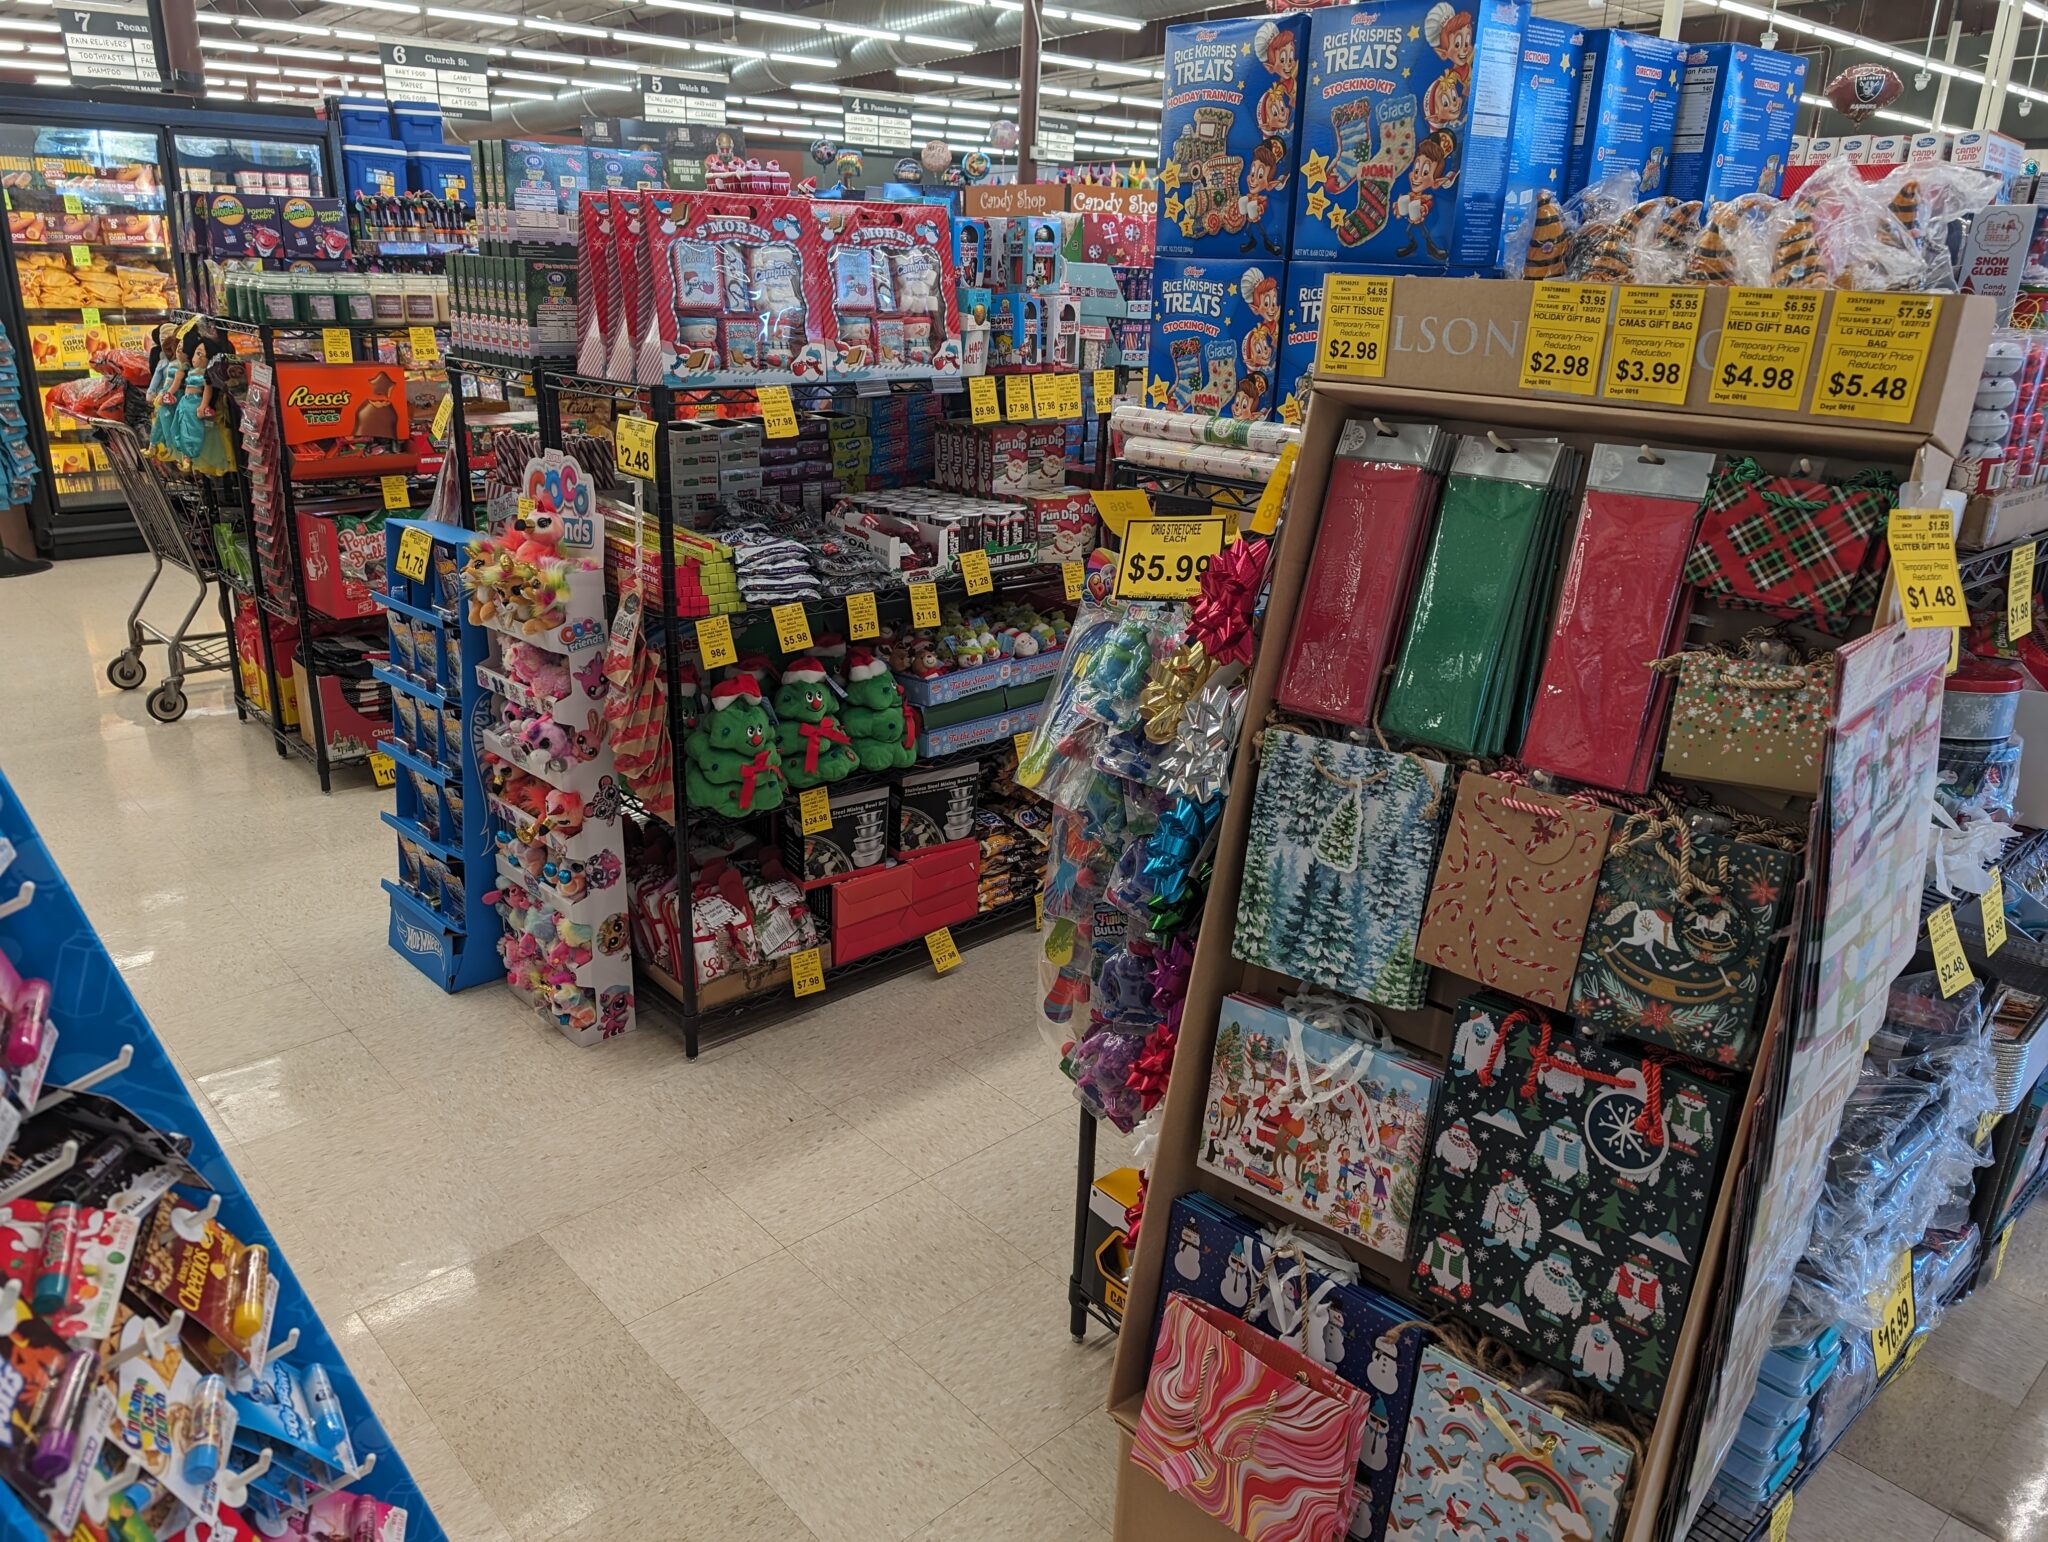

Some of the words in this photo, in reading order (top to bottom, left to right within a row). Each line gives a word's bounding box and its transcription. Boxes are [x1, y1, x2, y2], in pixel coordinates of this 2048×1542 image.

[74, 12, 91, 32] 7
[116, 21, 149, 33] Pecan
[70, 37, 88, 45] PAIN
[90, 39, 127, 48] RELIEVERS
[1323, 33, 1349, 51] RICE
[78, 52, 126, 62] TOOTHPASTE
[393, 46, 407, 64] 6
[425, 54, 456, 65] Church
[458, 57, 469, 67] St.
[1174, 48, 1195, 65] RICE
[1324, 44, 1398, 74] TREATS
[87, 66, 122, 76] SHAMPOO
[1175, 59, 1234, 86] TREATS
[1635, 66, 1662, 79] DIRECTIONS
[651, 77, 663, 93] 5
[678, 83, 699, 93] Welch
[701, 85, 710, 94] St.
[1323, 78, 1376, 99] STOCKING
[1376, 81, 1396, 94] KIT
[1754, 78, 1780, 92] DIRECTIONS
[851, 98, 861, 112] 4
[1167, 91, 1201, 110] HOLIDAY
[1202, 90, 1226, 101] TRAIN
[1227, 93, 1244, 105] KIT
[1378, 101, 1412, 121] Grace
[1955, 146, 1982, 156] CANDY
[1957, 154, 1978, 162] LAND
[1361, 164, 1394, 179] NOAH
[980, 190, 1013, 212] Candy
[1017, 192, 1046, 211] Shop
[1073, 192, 1123, 214] Candy
[696, 220, 771, 242] S'MORES
[851, 228, 915, 245] S'MORES
[1975, 256, 2010, 266] SNOW
[754, 265, 797, 282] Campfire
[1970, 266, 2008, 276] GLOBE
[1162, 280, 1182, 294] RICE
[1367, 287, 1388, 296] $4.95
[1983, 283, 2006, 292] Candy
[1163, 292, 1222, 318] TREATS
[1579, 295, 1606, 305] $3.95
[1669, 299, 1698, 310] $5.95
[1330, 305, 1350, 314] GIFT
[1353, 306, 1385, 316] TISSUE
[1783, 302, 1816, 313] $6.95
[1897, 307, 1933, 319] $7.95
[1332, 319, 1363, 329] Temporary
[1364, 322, 1380, 330] Price
[1533, 312, 1564, 321] HOLIDAY
[1566, 315, 1583, 323] GIFT
[1585, 316, 1600, 324] BAG
[1872, 317, 1893, 325] $2.47
[1618, 319, 1646, 328] CMAS
[1649, 320, 1670, 329] GIFT
[1672, 321, 1693, 331] BAG
[1727, 321, 1752, 331] MED
[1755, 323, 1781, 333] GIFT
[1784, 325, 1810, 335] BAG
[1339, 329, 1371, 338] Reduction
[1535, 330, 1572, 342] Temporary
[1574, 334, 1594, 342] Price
[1856, 328, 1896, 338] HOLIDAY
[1897, 331, 1920, 340] GIFT
[62, 339, 84, 347] CORN
[1329, 338, 1378, 360] $2.98
[1544, 341, 1581, 351] Reduction
[1867, 339, 1888, 348] BAG
[328, 350, 350, 359] $6.98
[415, 348, 435, 356] $6.98
[1530, 351, 1589, 377] $2.98
[1615, 358, 1681, 385] $3.98
[1722, 362, 1794, 390] $4.98
[1828, 371, 1908, 401] $5.48
[288, 386, 352, 407] Reese's
[975, 406, 995, 416] $9.98
[1009, 404, 1029, 413] $7.98
[1038, 402, 1055, 411] $7.98
[1059, 402, 1078, 411] $7.98
[304, 413, 340, 425] Trees
[767, 418, 793, 428] $17.98
[995, 441, 1011, 453] Fun
[1012, 439, 1027, 452] Dip
[1030, 437, 1047, 447] Fun
[1049, 434, 1064, 447] Dip
[620, 445, 649, 471] $2.48
[1040, 511, 1059, 522] Fun
[1061, 510, 1080, 523] Dip
[1166, 523, 1202, 536] STRETCHEE
[1928, 521, 1949, 531] $1.59
[1163, 535, 1187, 543] EACH
[1893, 542, 1921, 551] GLITTER
[1922, 542, 1936, 551] GIFT
[1937, 542, 1950, 550] TAG
[402, 551, 424, 575] $1.78
[1004, 552, 1029, 563] Banks
[907, 575, 931, 583] COAL
[968, 577, 989, 588] $1.28
[1907, 585, 1956, 610] $1.48
[916, 611, 937, 621] $1.18
[2010, 601, 2029, 625] $1.98
[853, 622, 876, 633] $5.78
[568, 634, 604, 652] Friends
[784, 633, 808, 645] $5.98
[711, 648, 727, 658] 98¢
[973, 673, 996, 686] Season
[957, 684, 988, 696] ORNAMENTS
[927, 783, 940, 791] Steel
[957, 777, 968, 785] Bowl
[804, 814, 828, 826] $24.98
[407, 927, 421, 950] HOT
[935, 951, 957, 965] $17.98
[1941, 955, 1965, 984] $2.48
[797, 976, 820, 990] $7.98
[178, 1248, 209, 1312] Cheerios
[1877, 1297, 1911, 1356] $16.99
[274, 1362, 293, 1405] BERRY
[153, 1392, 172, 1454] Crunch
[279, 1404, 300, 1440] BOO
